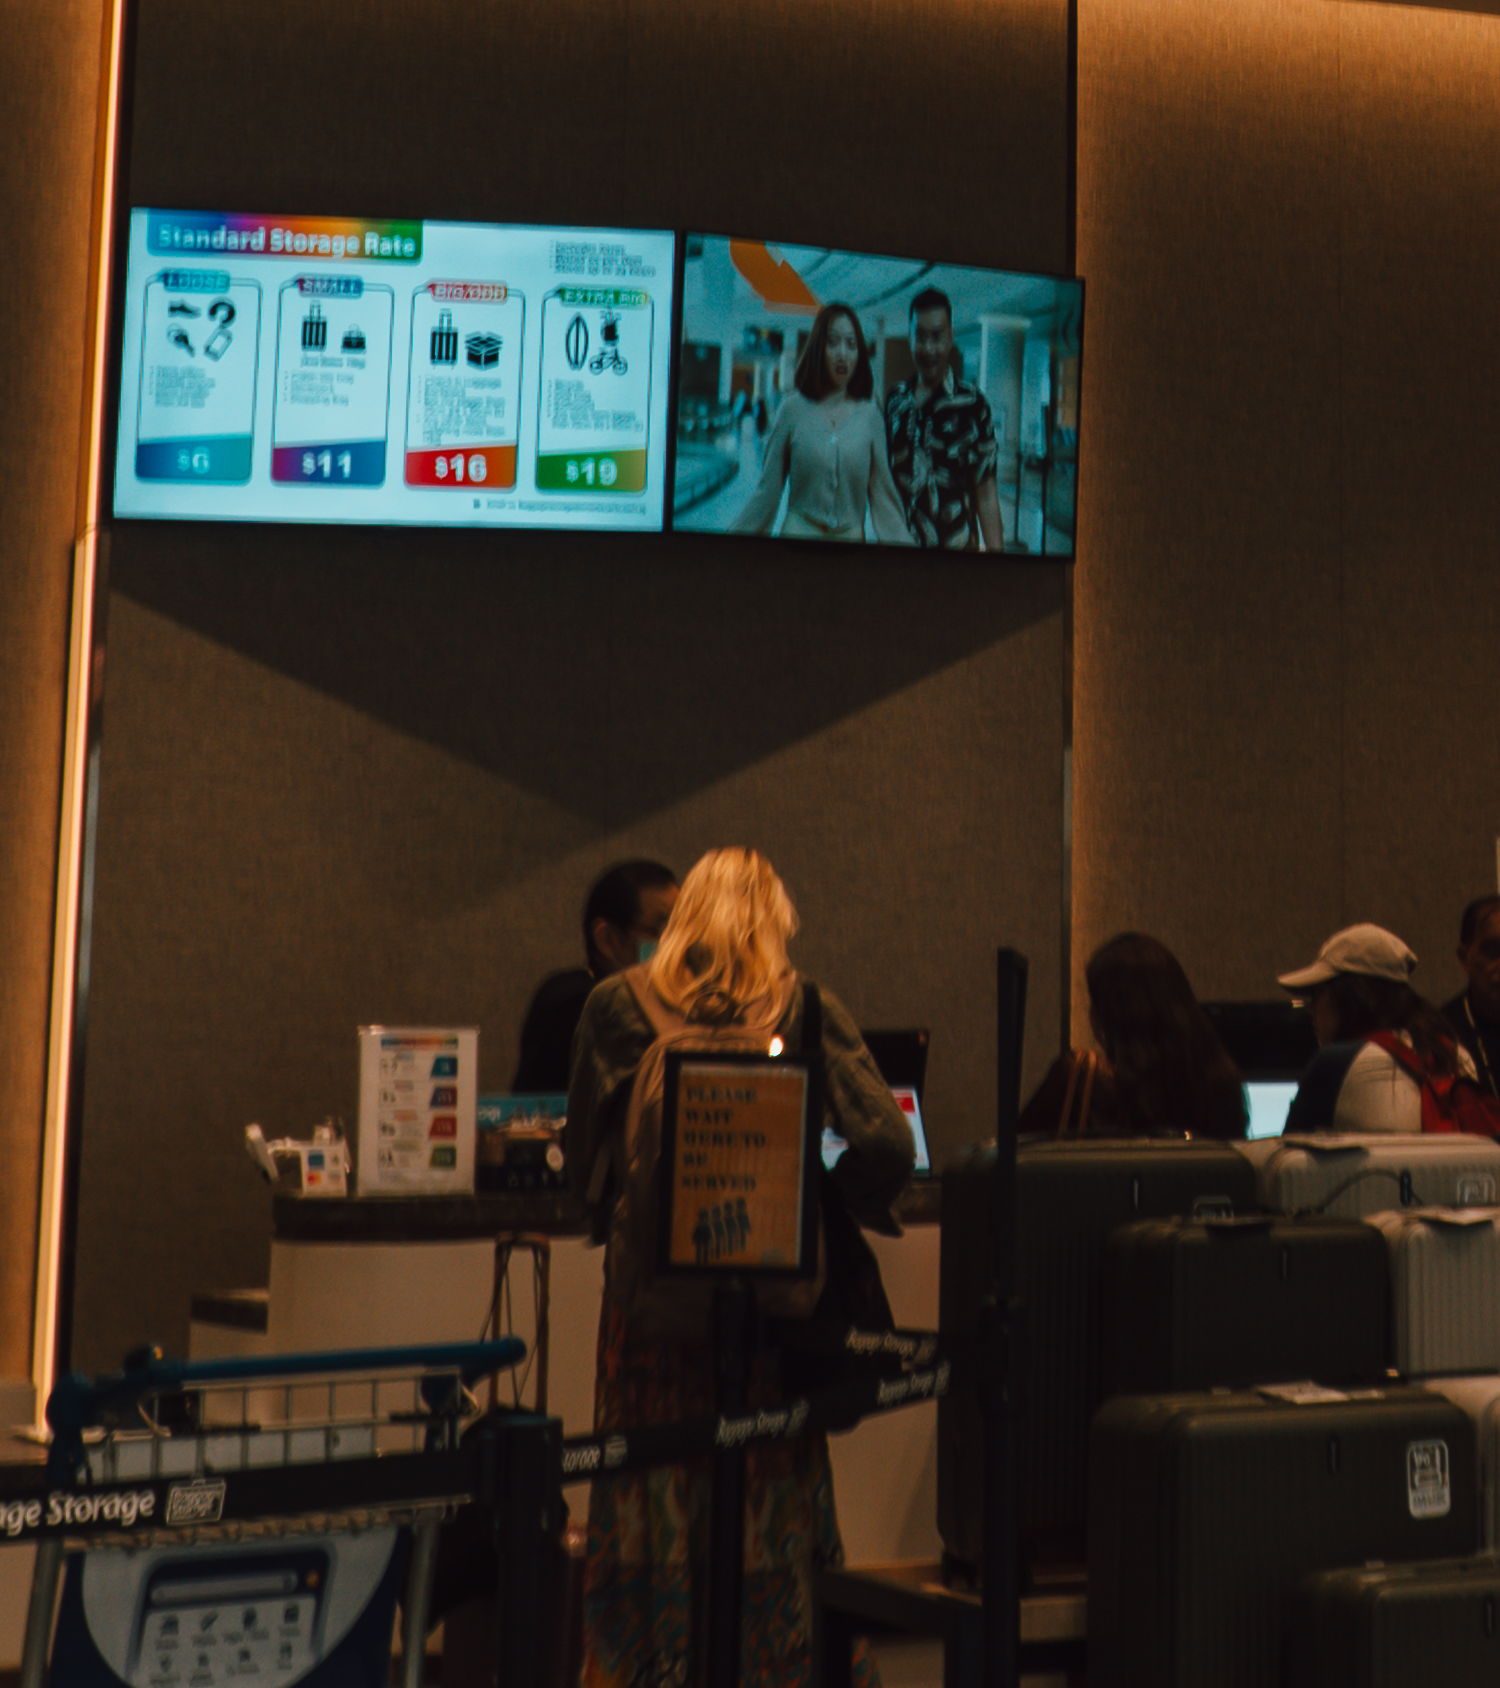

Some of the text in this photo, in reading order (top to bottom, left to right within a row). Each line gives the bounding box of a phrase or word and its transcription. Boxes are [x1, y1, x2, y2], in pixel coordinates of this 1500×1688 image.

[158, 223, 416, 259] Standard Storage Rate
[301, 449, 352, 478] $11
[434, 453, 487, 483] $16
[565, 457, 618, 486] $19
[686, 1086, 757, 1104] PLEASE
[45, 1489, 157, 1527] Storage
